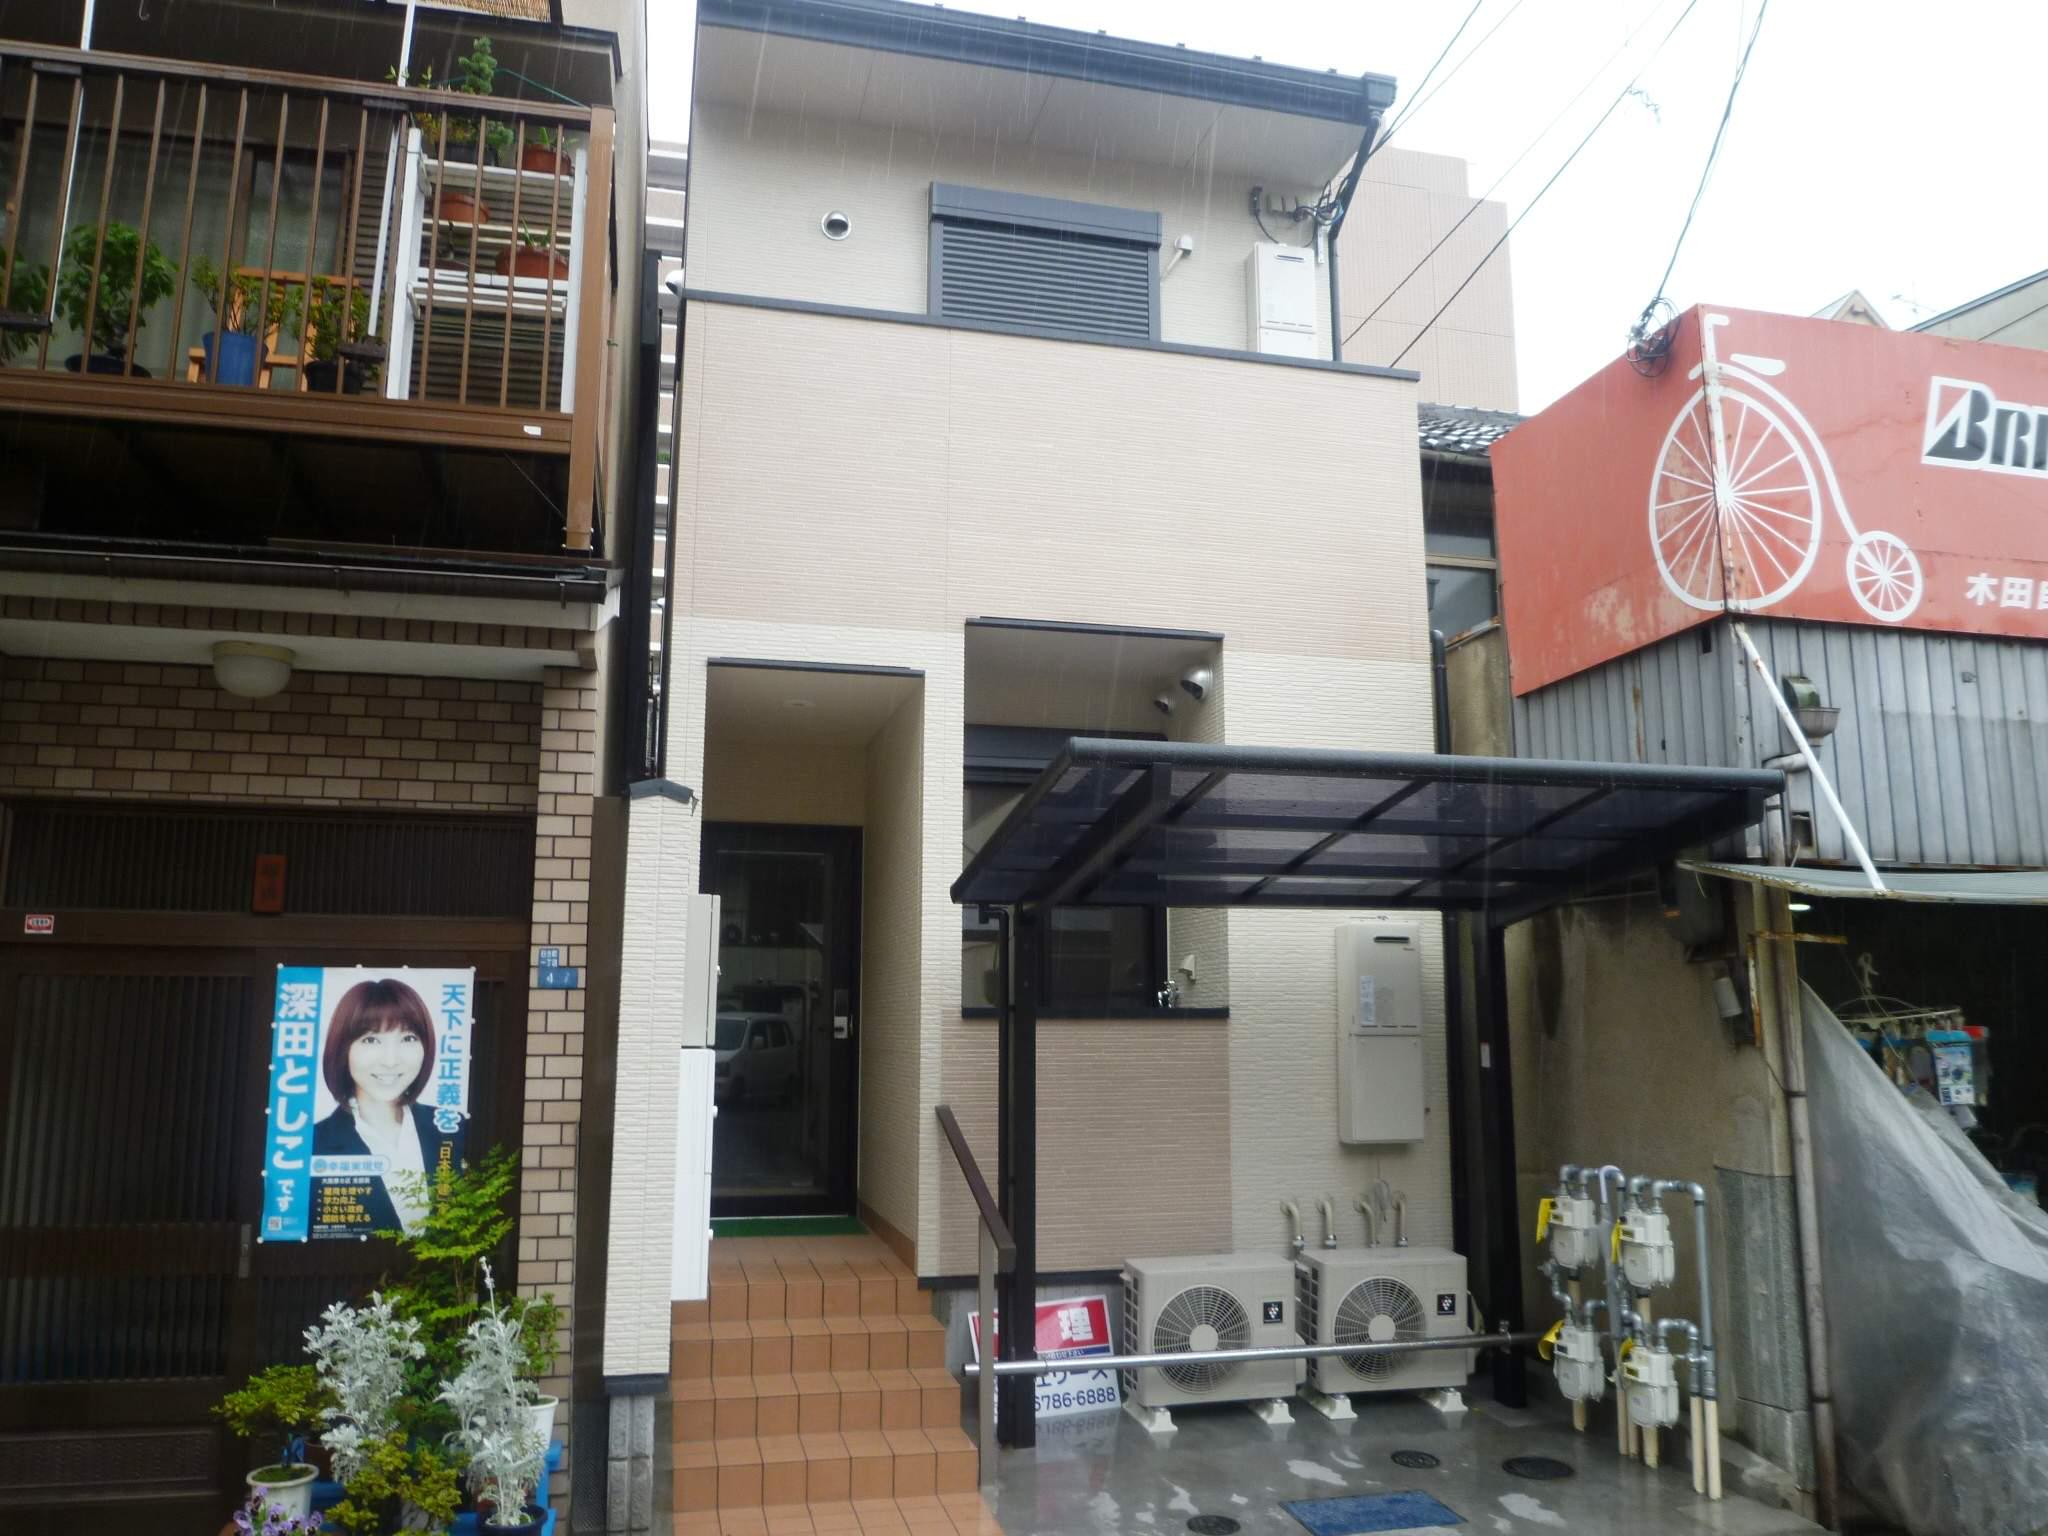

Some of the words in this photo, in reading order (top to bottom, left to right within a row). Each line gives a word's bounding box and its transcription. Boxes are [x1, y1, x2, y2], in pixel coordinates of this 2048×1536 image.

[434, 984, 467, 1132] 天下に正義を
